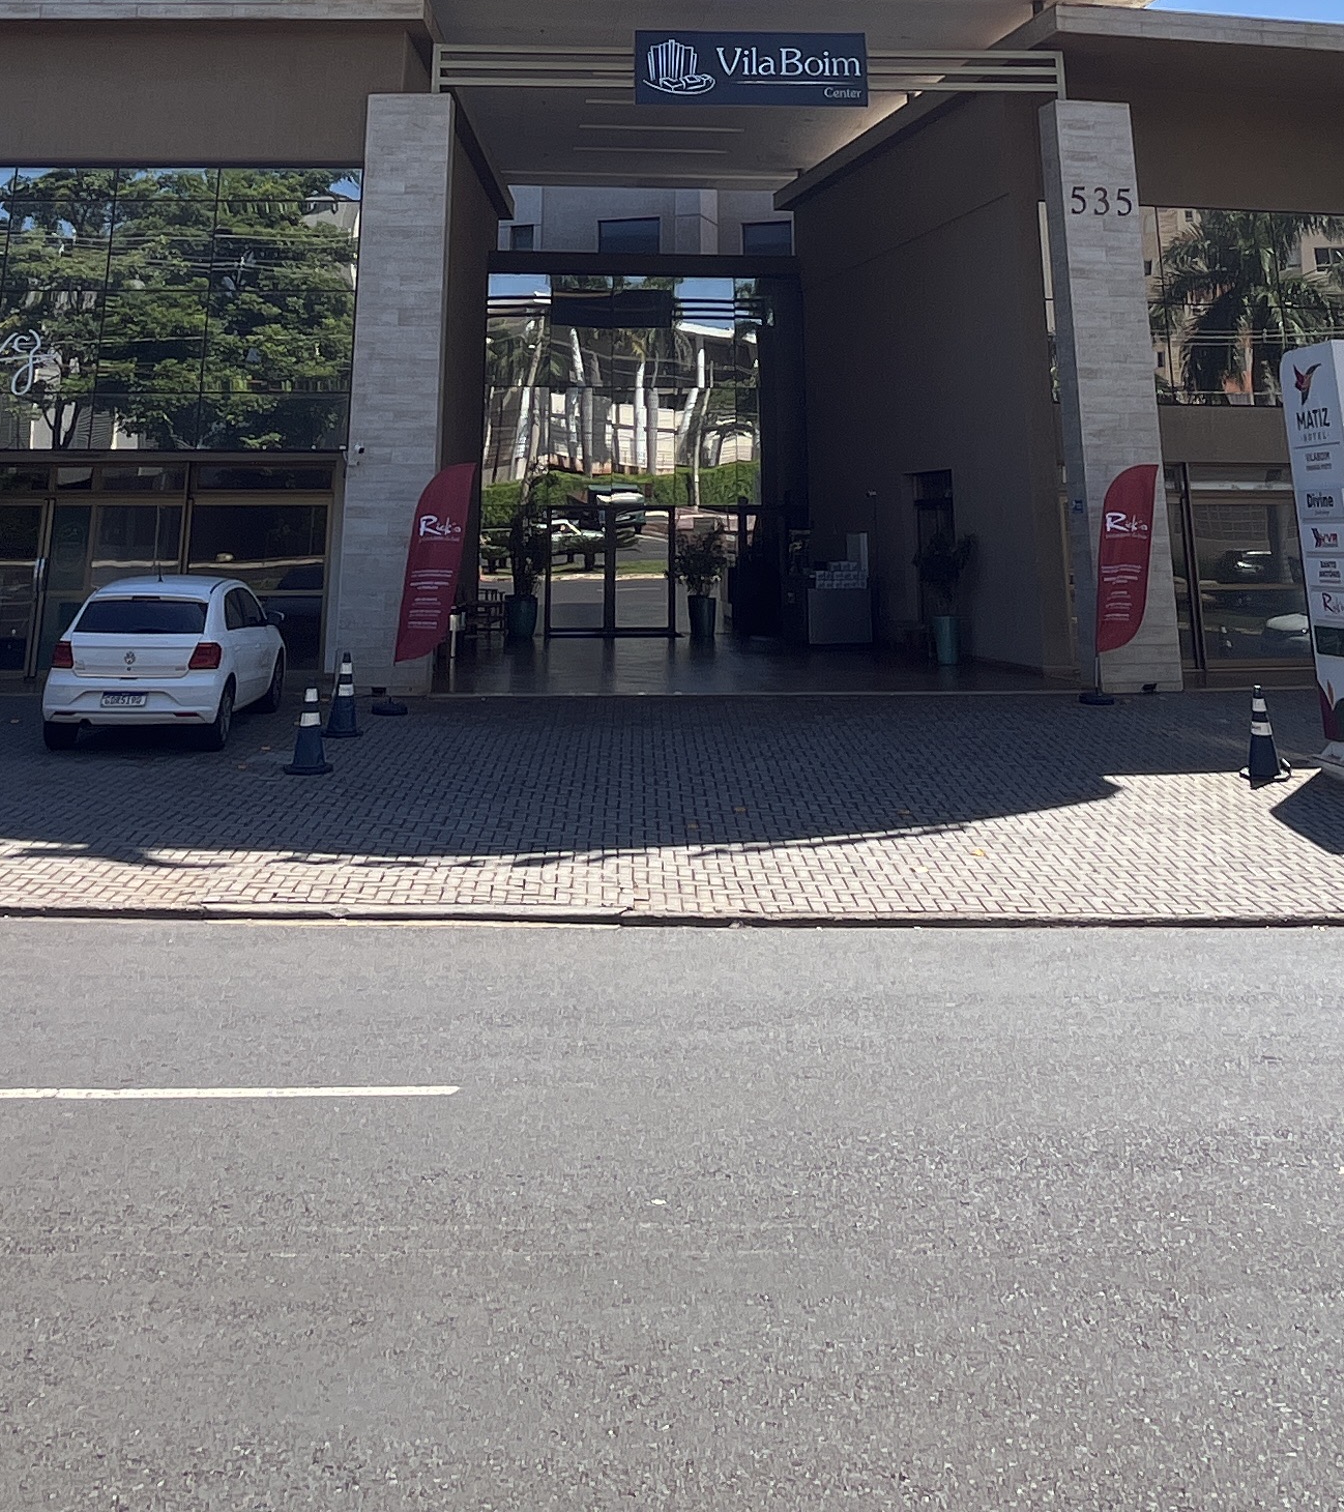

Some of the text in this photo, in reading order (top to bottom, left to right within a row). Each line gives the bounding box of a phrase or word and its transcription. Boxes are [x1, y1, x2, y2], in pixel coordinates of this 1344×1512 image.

[823, 87, 861, 99] Center
[1071, 186, 1133, 216] 535
[1296, 408, 1330, 430] MATIZ
[1306, 492, 1334, 508] Divine
